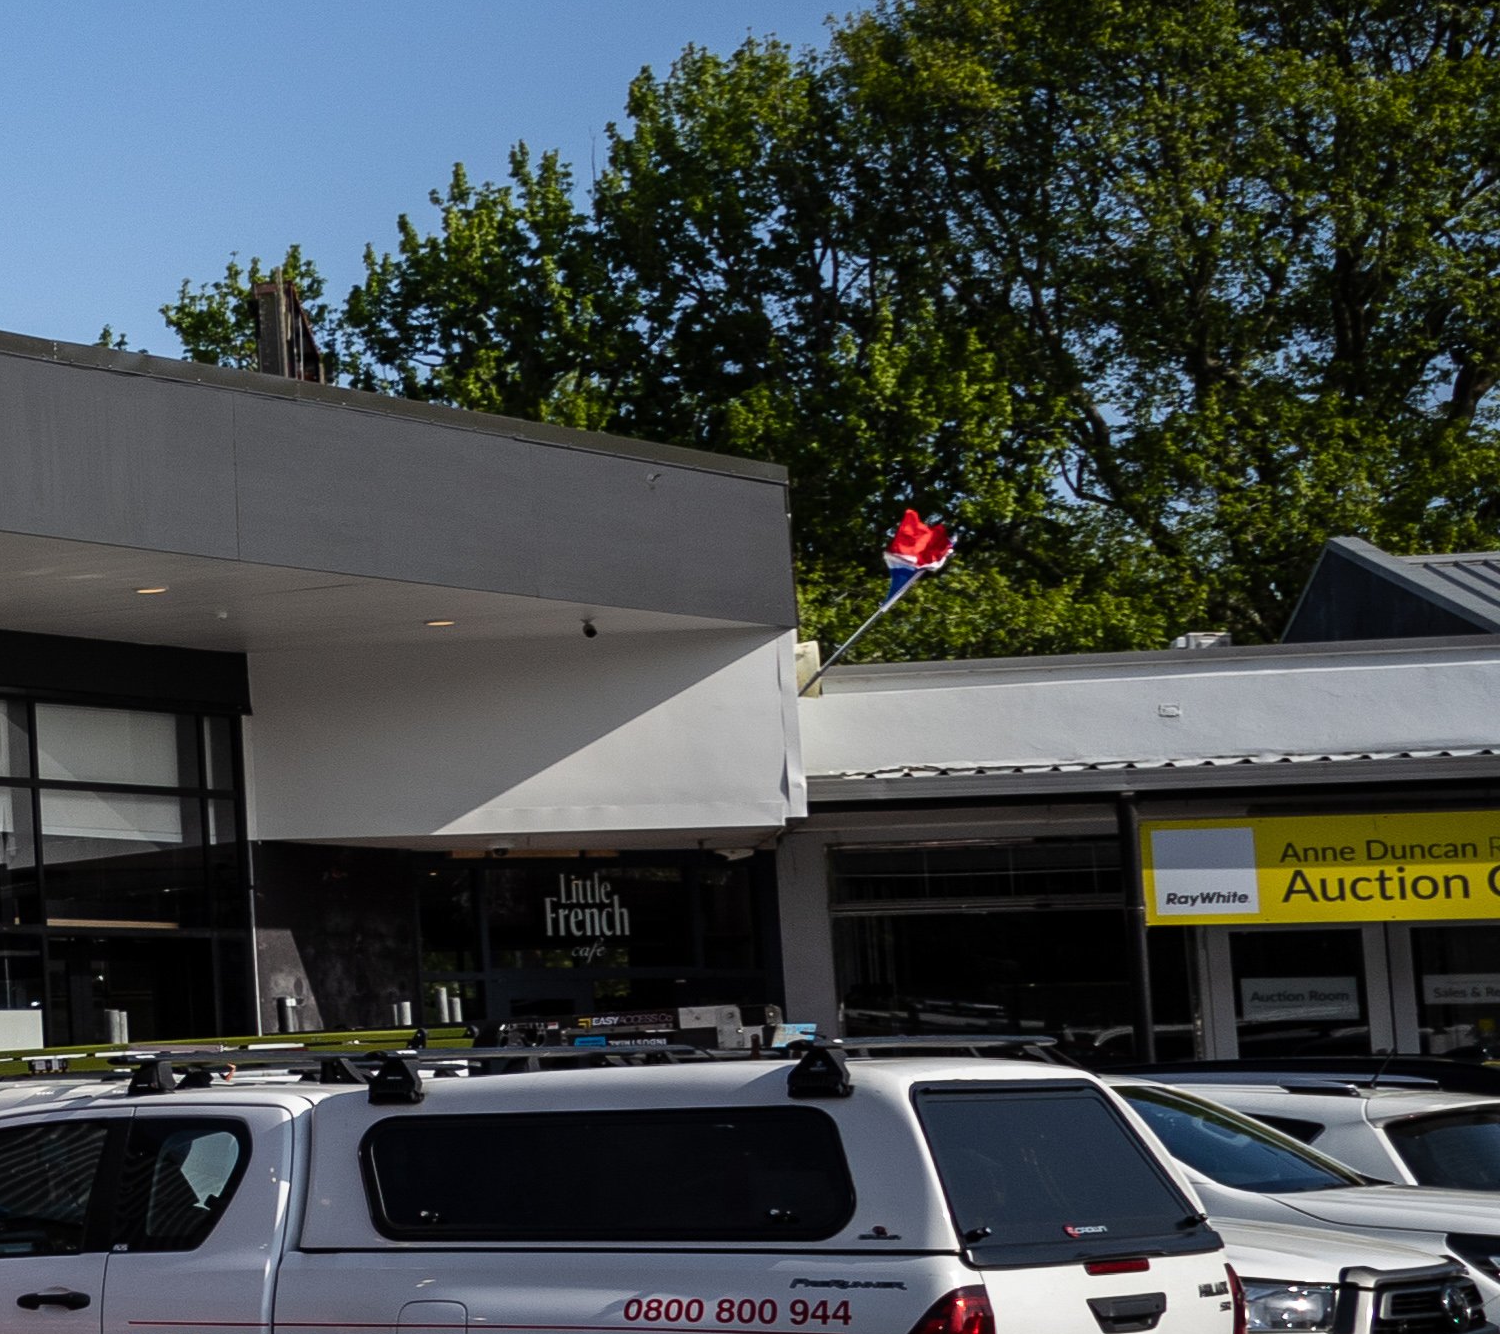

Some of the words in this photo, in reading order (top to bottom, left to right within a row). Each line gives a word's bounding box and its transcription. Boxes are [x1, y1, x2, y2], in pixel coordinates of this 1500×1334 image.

[1280, 842, 1356, 863] Anne
[1365, 838, 1479, 861] Duncan
[559, 872, 611, 904] Little
[1281, 864, 1471, 904] Auction
[544, 894, 630, 936] French
[1251, 989, 1304, 1003] Auction
[1308, 989, 1349, 1002] Room
[623, 1298, 705, 1324] 0800
[715, 1299, 778, 1325] 800
[789, 1300, 852, 1327] 944
